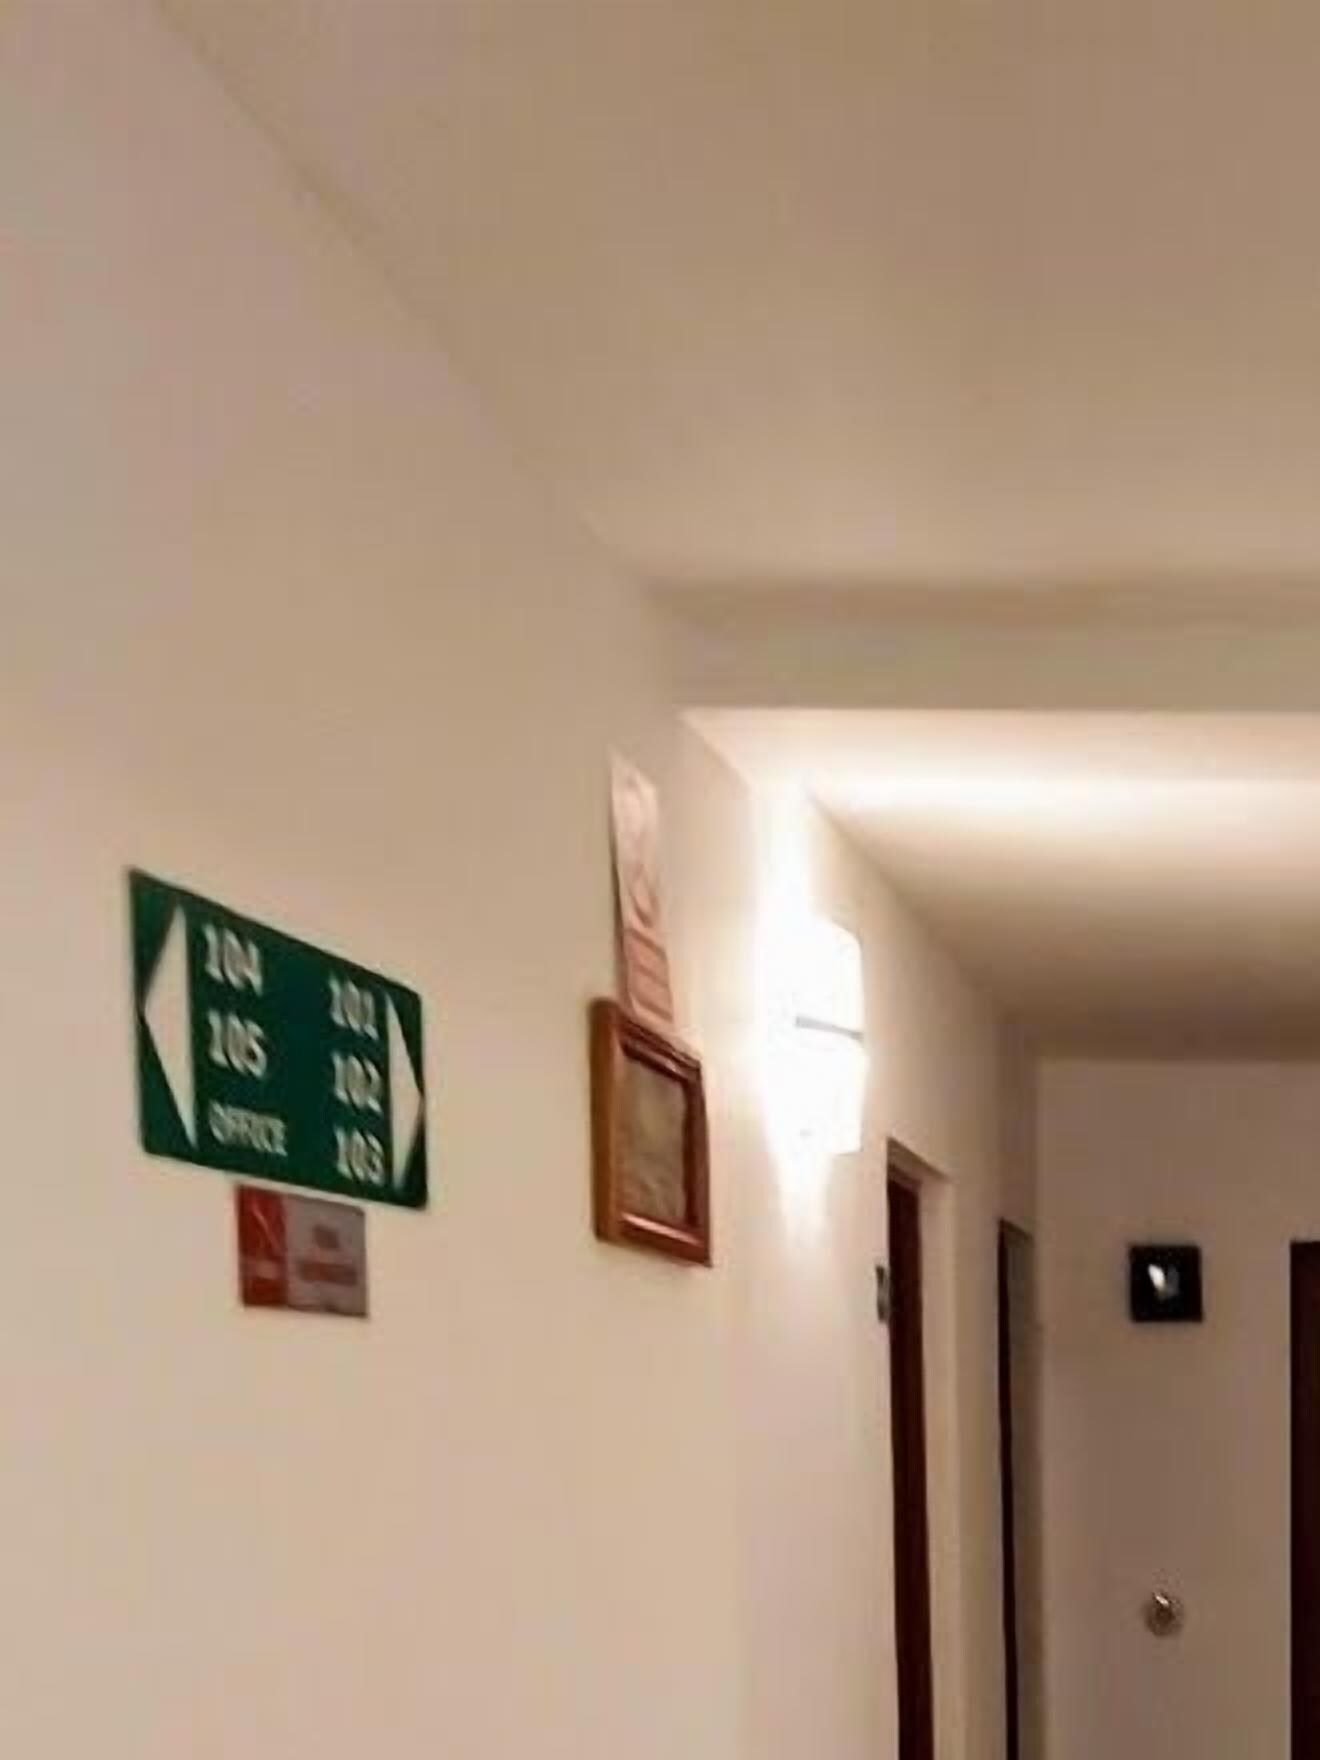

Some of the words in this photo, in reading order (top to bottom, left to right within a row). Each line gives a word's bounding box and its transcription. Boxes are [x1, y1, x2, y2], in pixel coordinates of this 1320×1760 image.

[203, 922, 264, 998] 104
[328, 972, 381, 1042] 101
[331, 1050, 384, 1115] 102
